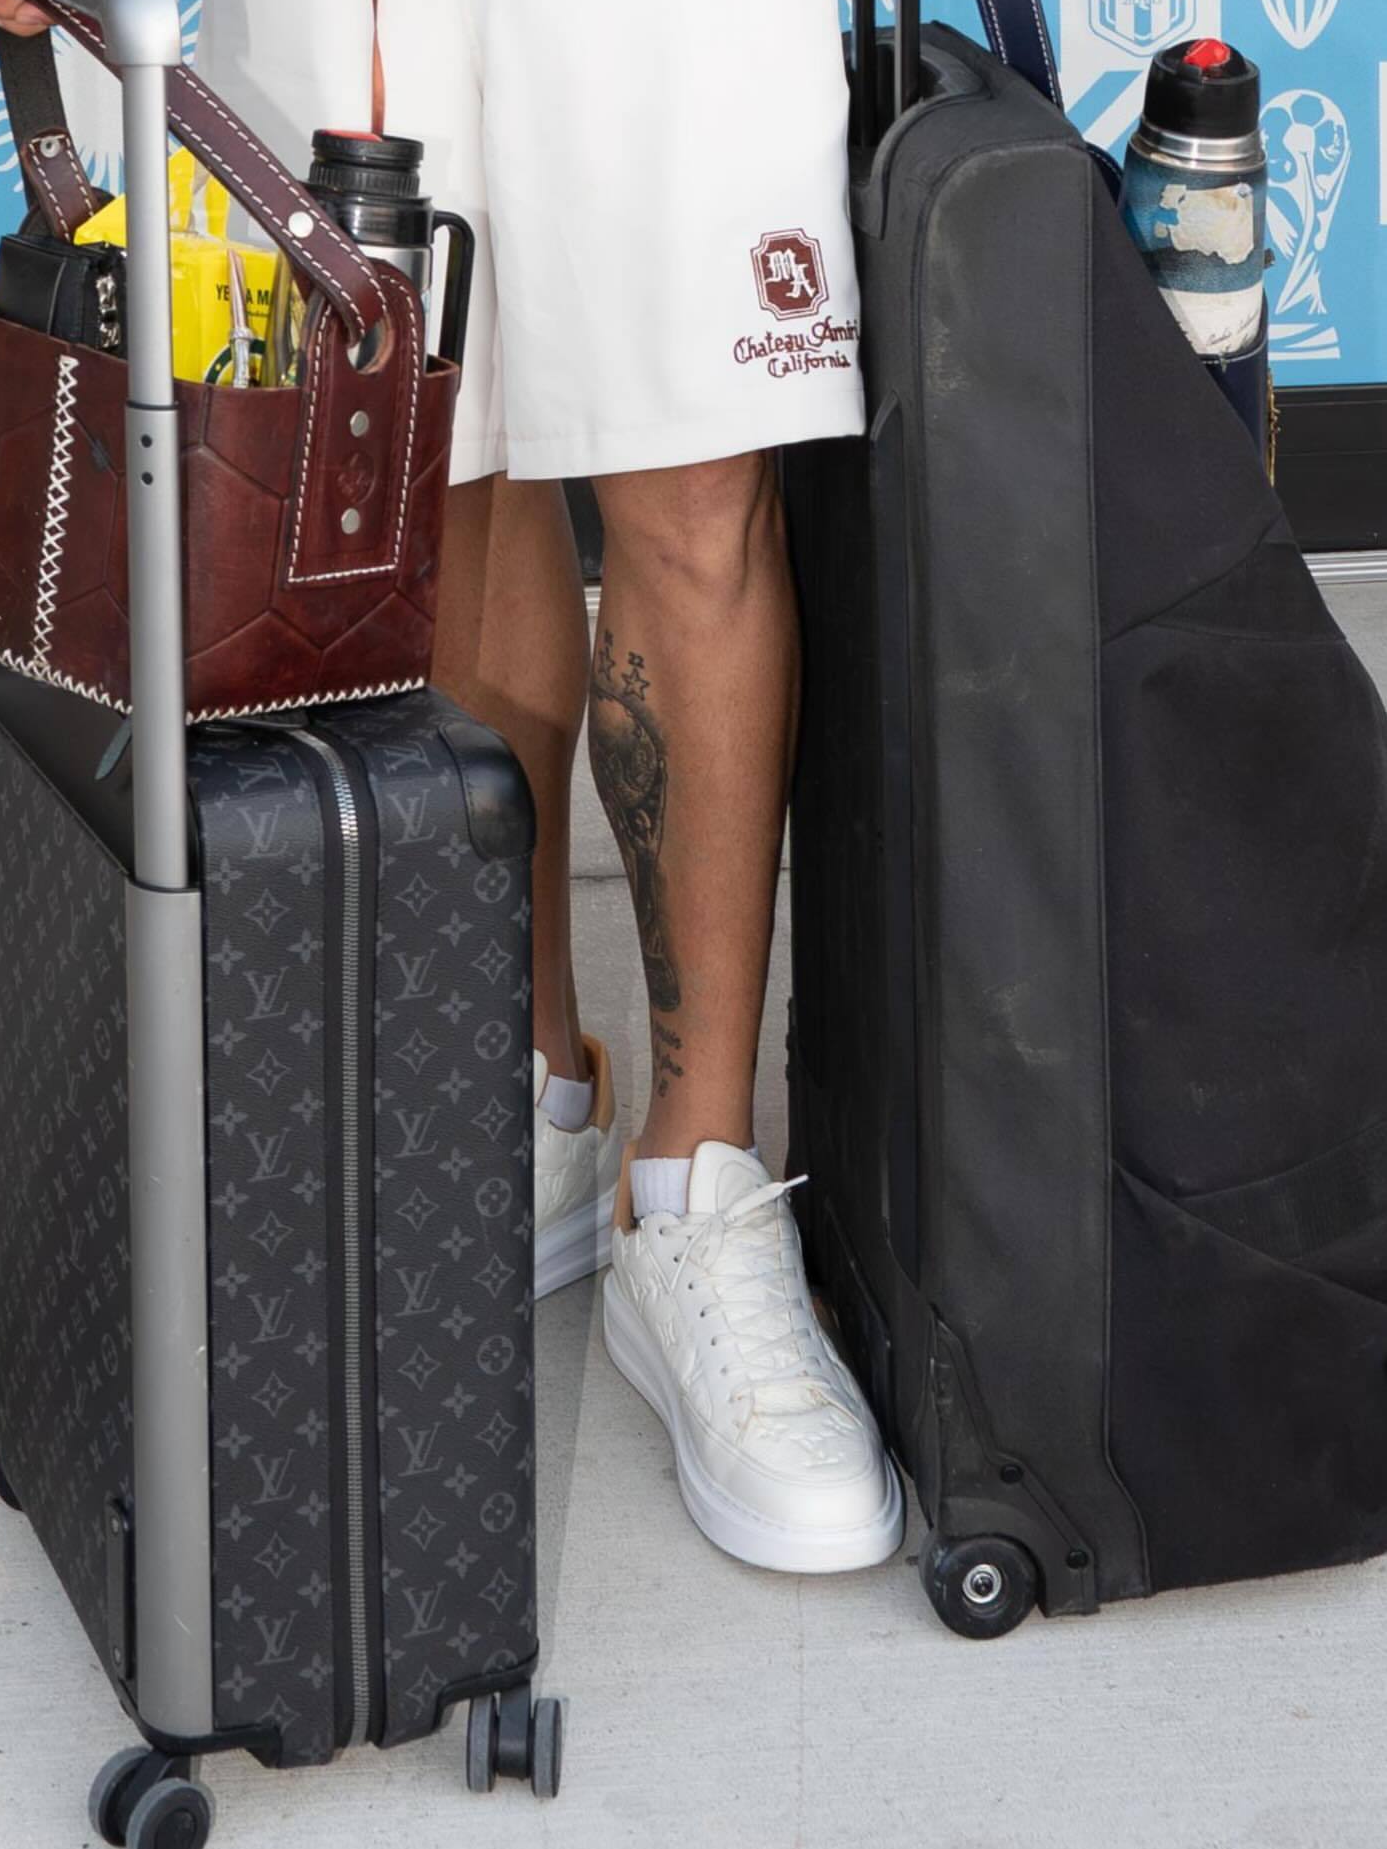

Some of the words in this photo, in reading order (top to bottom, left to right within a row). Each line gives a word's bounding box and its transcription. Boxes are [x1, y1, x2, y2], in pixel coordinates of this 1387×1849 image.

[216, 283, 254, 305] YEA
[733, 331, 805, 364] Chateau
[767, 350, 851, 378] California
